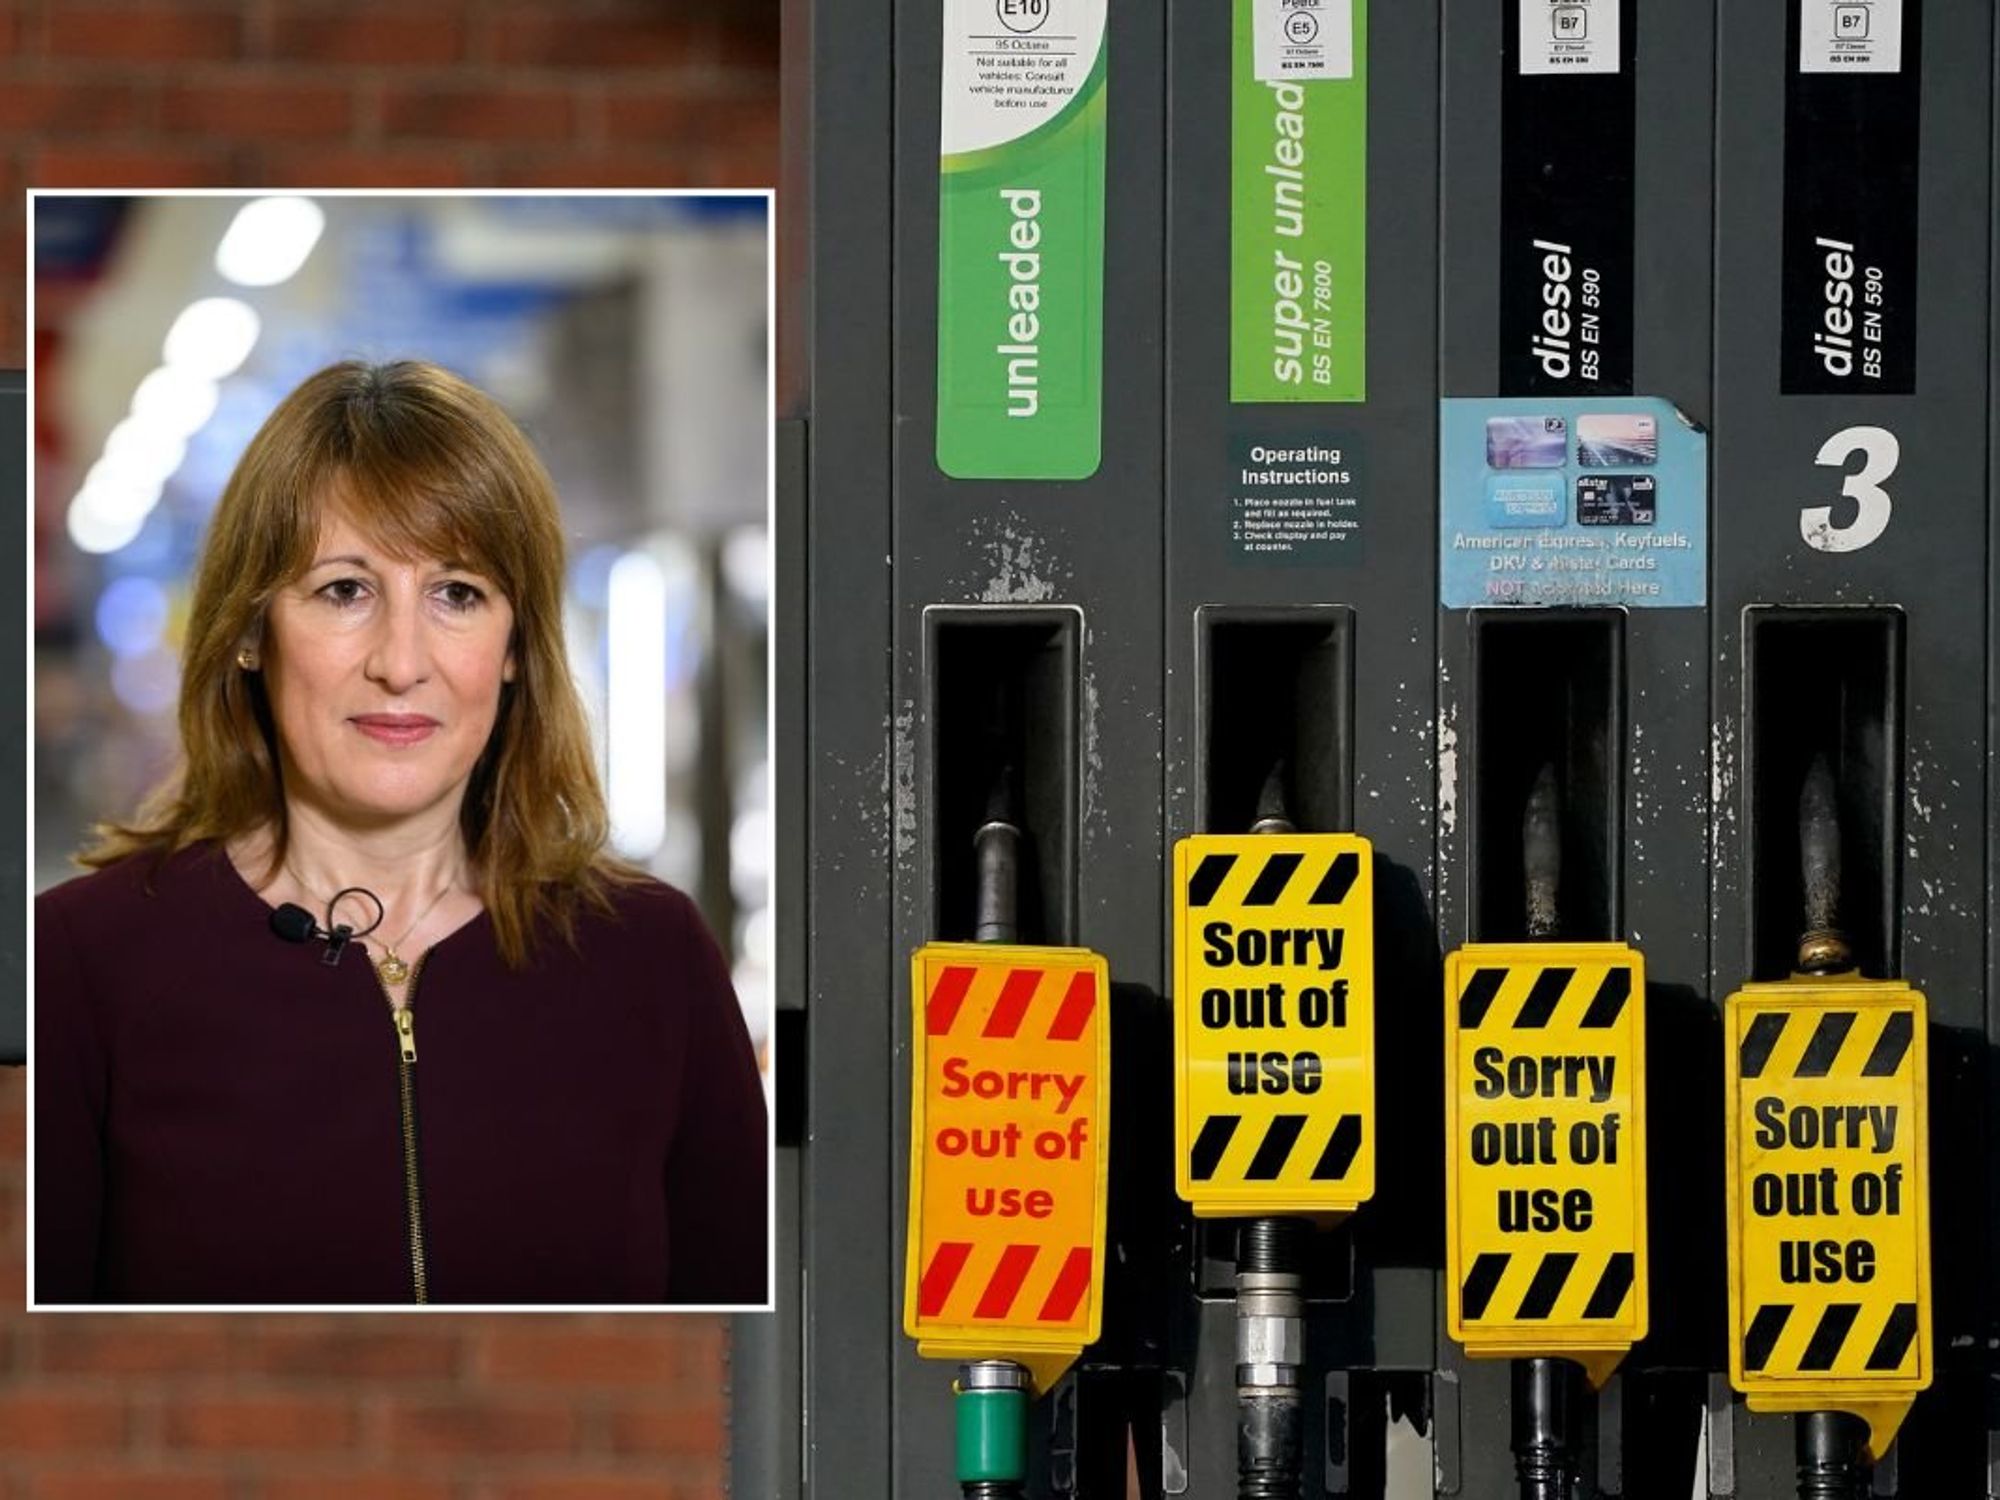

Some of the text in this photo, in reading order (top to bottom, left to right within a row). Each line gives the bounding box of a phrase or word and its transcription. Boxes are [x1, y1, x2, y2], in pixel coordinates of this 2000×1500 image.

[1004, 0, 1042, 14] E10
[1292, 22, 1310, 35] E5
[1561, 16, 1579, 29] B7
[1842, 15, 1861, 28] B7
[977, 57, 1068, 68] Not suitable for all
[1025, 71, 1065, 82] Consult
[969, 85, 1074, 96] vehicle manufacturer
[994, 98, 1048, 109] before use
[997, 189, 1041, 417] unleaded
[1275, 250, 1309, 385] super
[1314, 261, 1331, 384] BS EN 7800
[1533, 240, 1571, 379] diesel
[1582, 269, 1600, 380] BS EN 590
[1815, 237, 1853, 376] diesel
[1864, 267, 1883, 378] BS EN 590
[1242, 468, 1351, 485] Instructions
[1250, 445, 1341, 465] Operating
[1233, 498, 1242, 507] 1.
[1244, 498, 1270, 507] Place
[1304, 498, 1314, 506] in
[1316, 498, 1334, 506] fuel
[1800, 425, 1899, 552] 3
[1244, 509, 1262, 517] and
[1329, 532, 1347, 541] pay
[1615, 531, 1692, 549] Keyfuels,
[1490, 555, 1526, 570] DKV
[1531, 556, 1543, 570] &
[1606, 555, 1655, 570] Cards
[1486, 580, 1526, 596] NOT
[1618, 580, 1661, 595] Here
[1203, 921, 1346, 970] Sorry
[1201, 979, 1349, 1030] out of
[942, 1057, 1086, 1114] Sorry
[1227, 1050, 1323, 1096] use
[1473, 1046, 1616, 1103] Sorry
[935, 1117, 1088, 1161] out of
[1471, 1113, 1621, 1167] out of
[1754, 1096, 1898, 1154] Sorry
[966, 1186, 1054, 1219] use
[1497, 1188, 1593, 1233] use
[1752, 1162, 1903, 1218] out of
[1779, 1239, 1876, 1285] use
